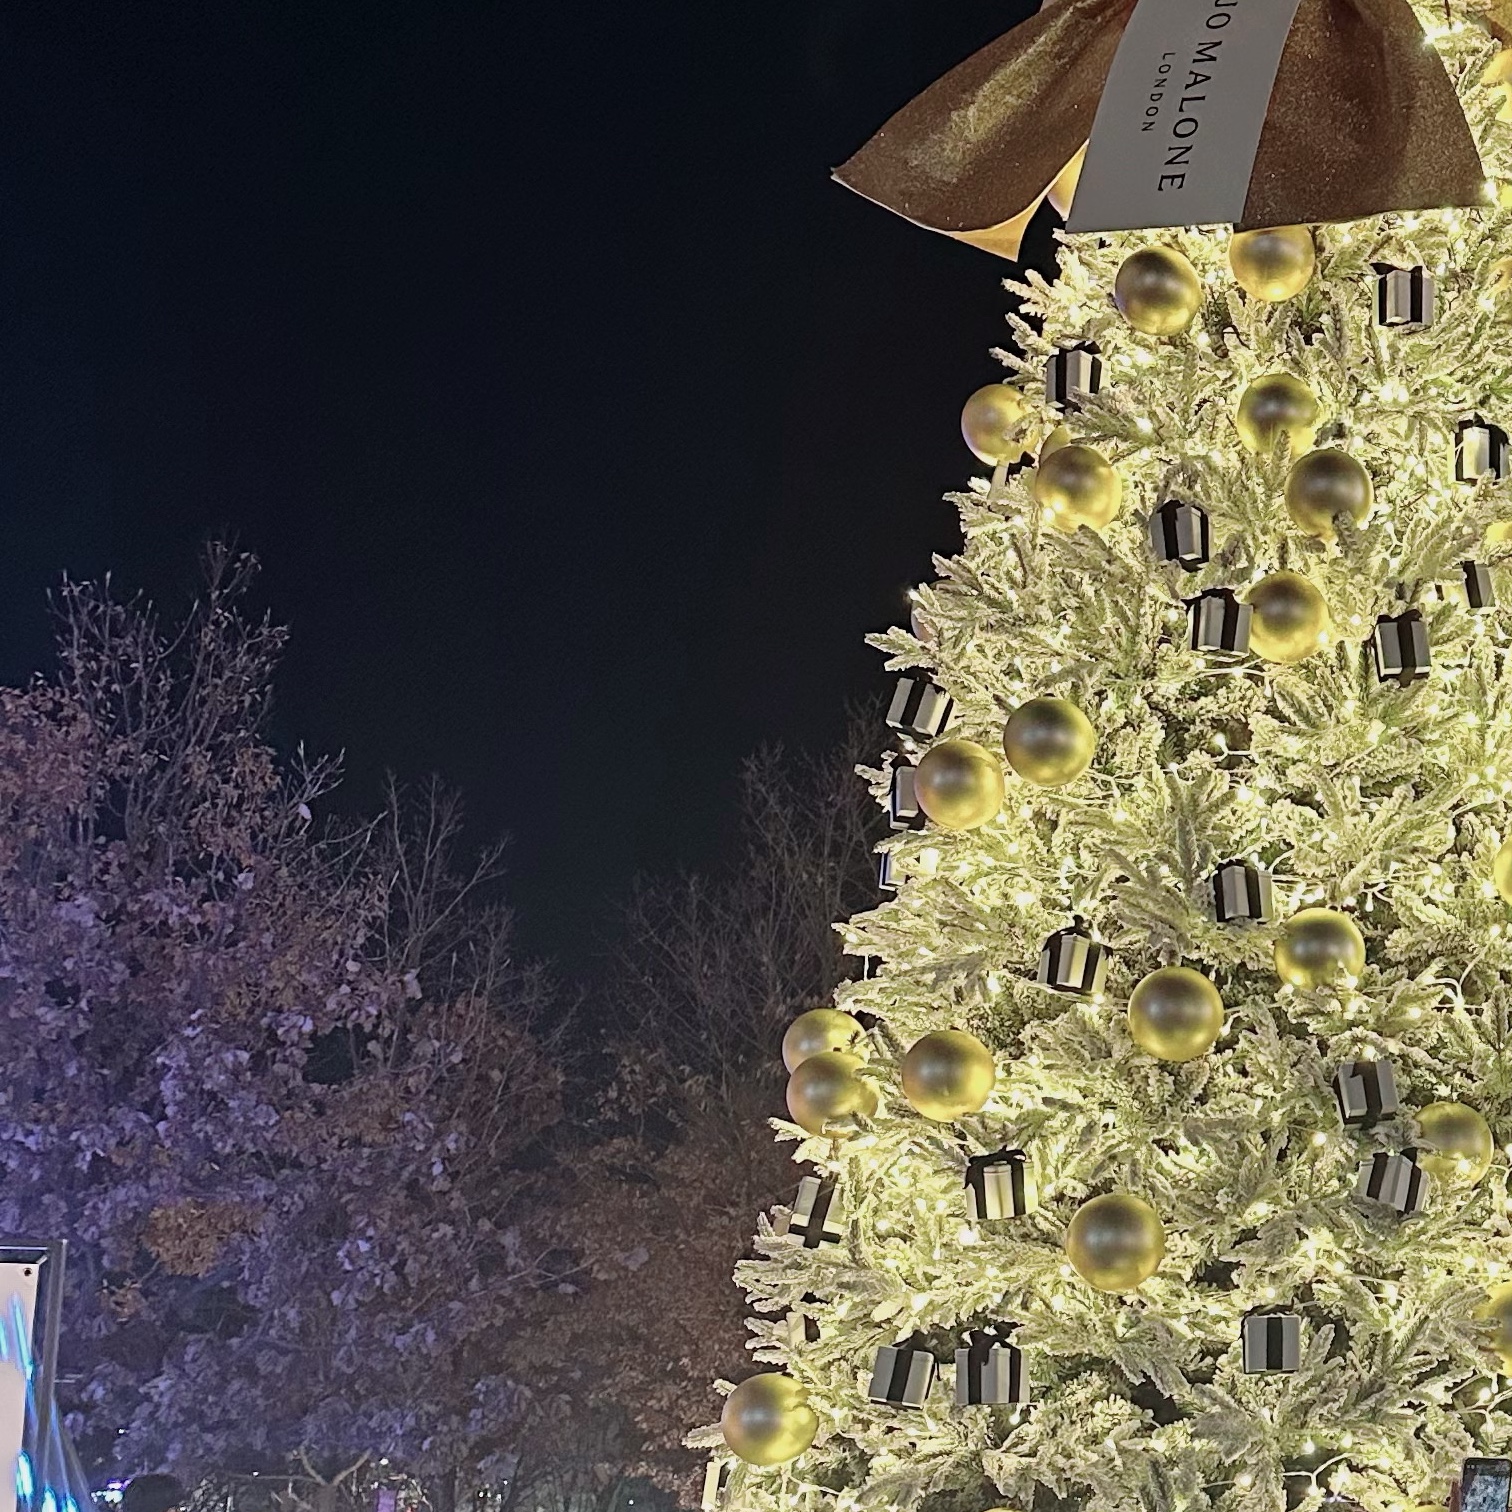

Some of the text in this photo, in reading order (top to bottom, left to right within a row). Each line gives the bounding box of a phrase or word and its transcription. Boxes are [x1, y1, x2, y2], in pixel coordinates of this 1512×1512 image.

[1141, 52, 1176, 132] LONDON
[1157, 0, 1238, 192] JO MALONE
